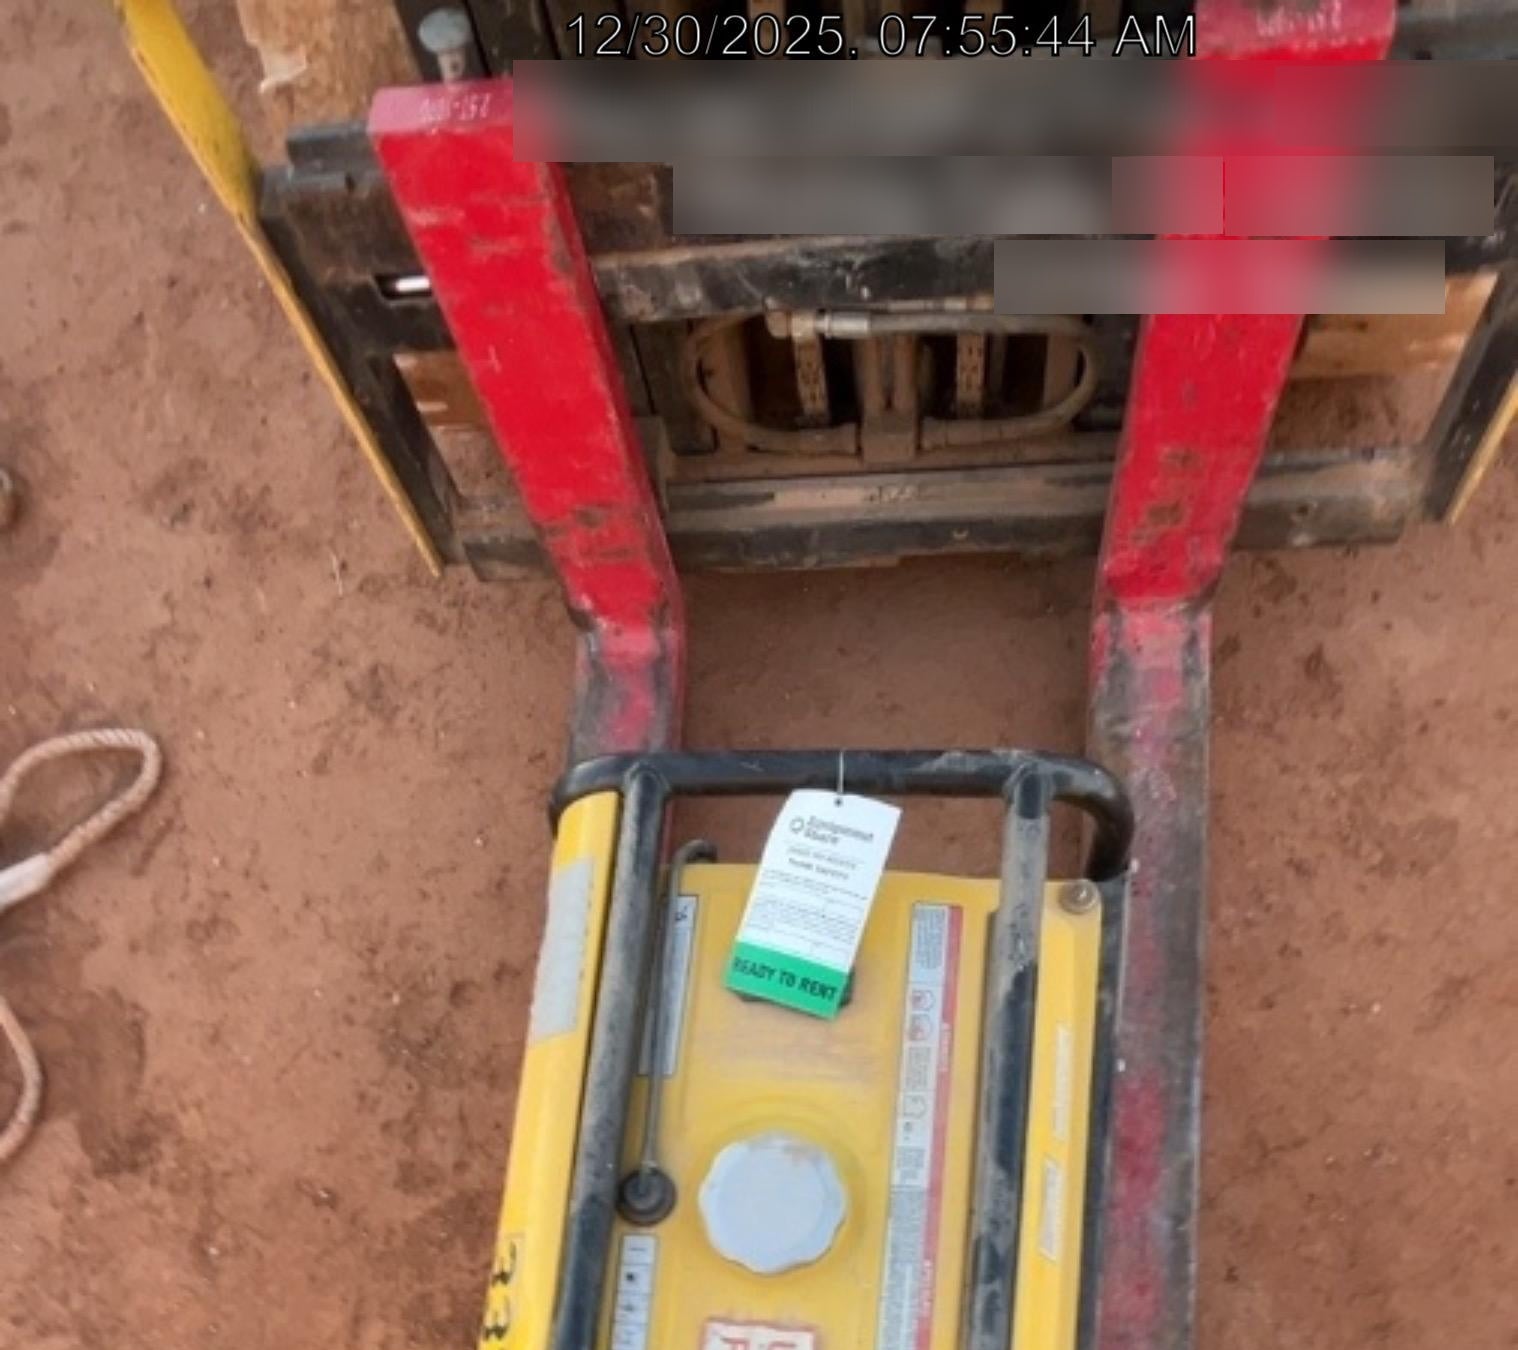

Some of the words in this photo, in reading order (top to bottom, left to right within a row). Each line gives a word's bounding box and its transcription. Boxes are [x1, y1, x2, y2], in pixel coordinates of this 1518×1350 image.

[733, 957, 777, 981] READY
[779, 969, 797, 988] TO
[799, 977, 838, 1001] RENT
